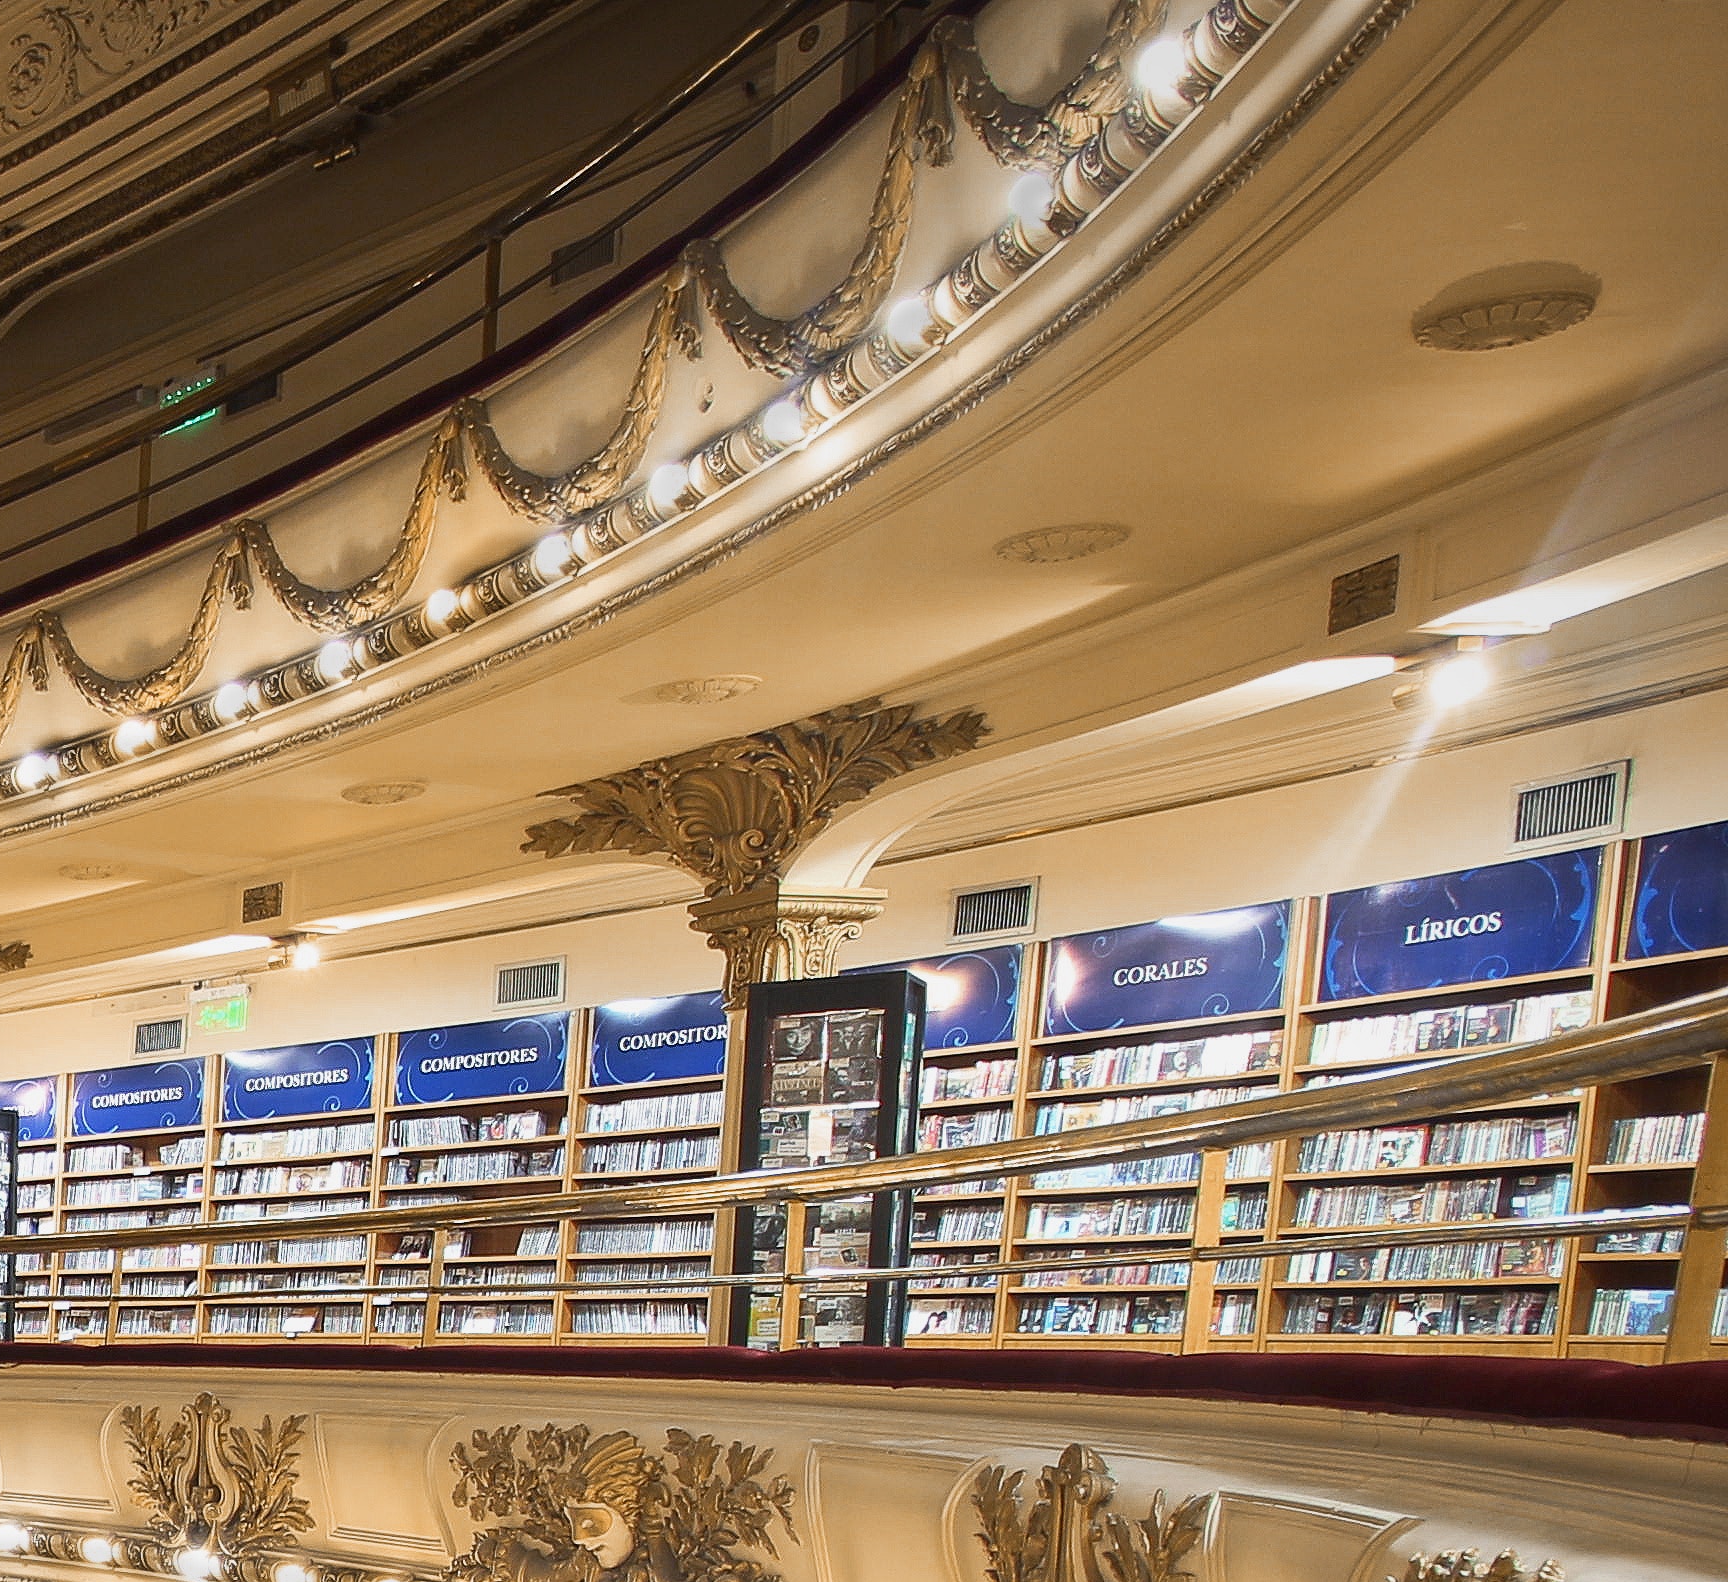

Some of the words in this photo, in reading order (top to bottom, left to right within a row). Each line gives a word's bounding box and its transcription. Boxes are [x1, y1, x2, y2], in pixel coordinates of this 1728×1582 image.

[1403, 909, 1504, 947] LÍRICOS
[1112, 956, 1209, 988] CORALES
[619, 1022, 729, 1052] COMPOSITOR
[420, 1046, 539, 1075] COMPOSITORES
[245, 1067, 349, 1094] COMPOSITORES
[92, 1086, 183, 1109] COMPOSITORES
